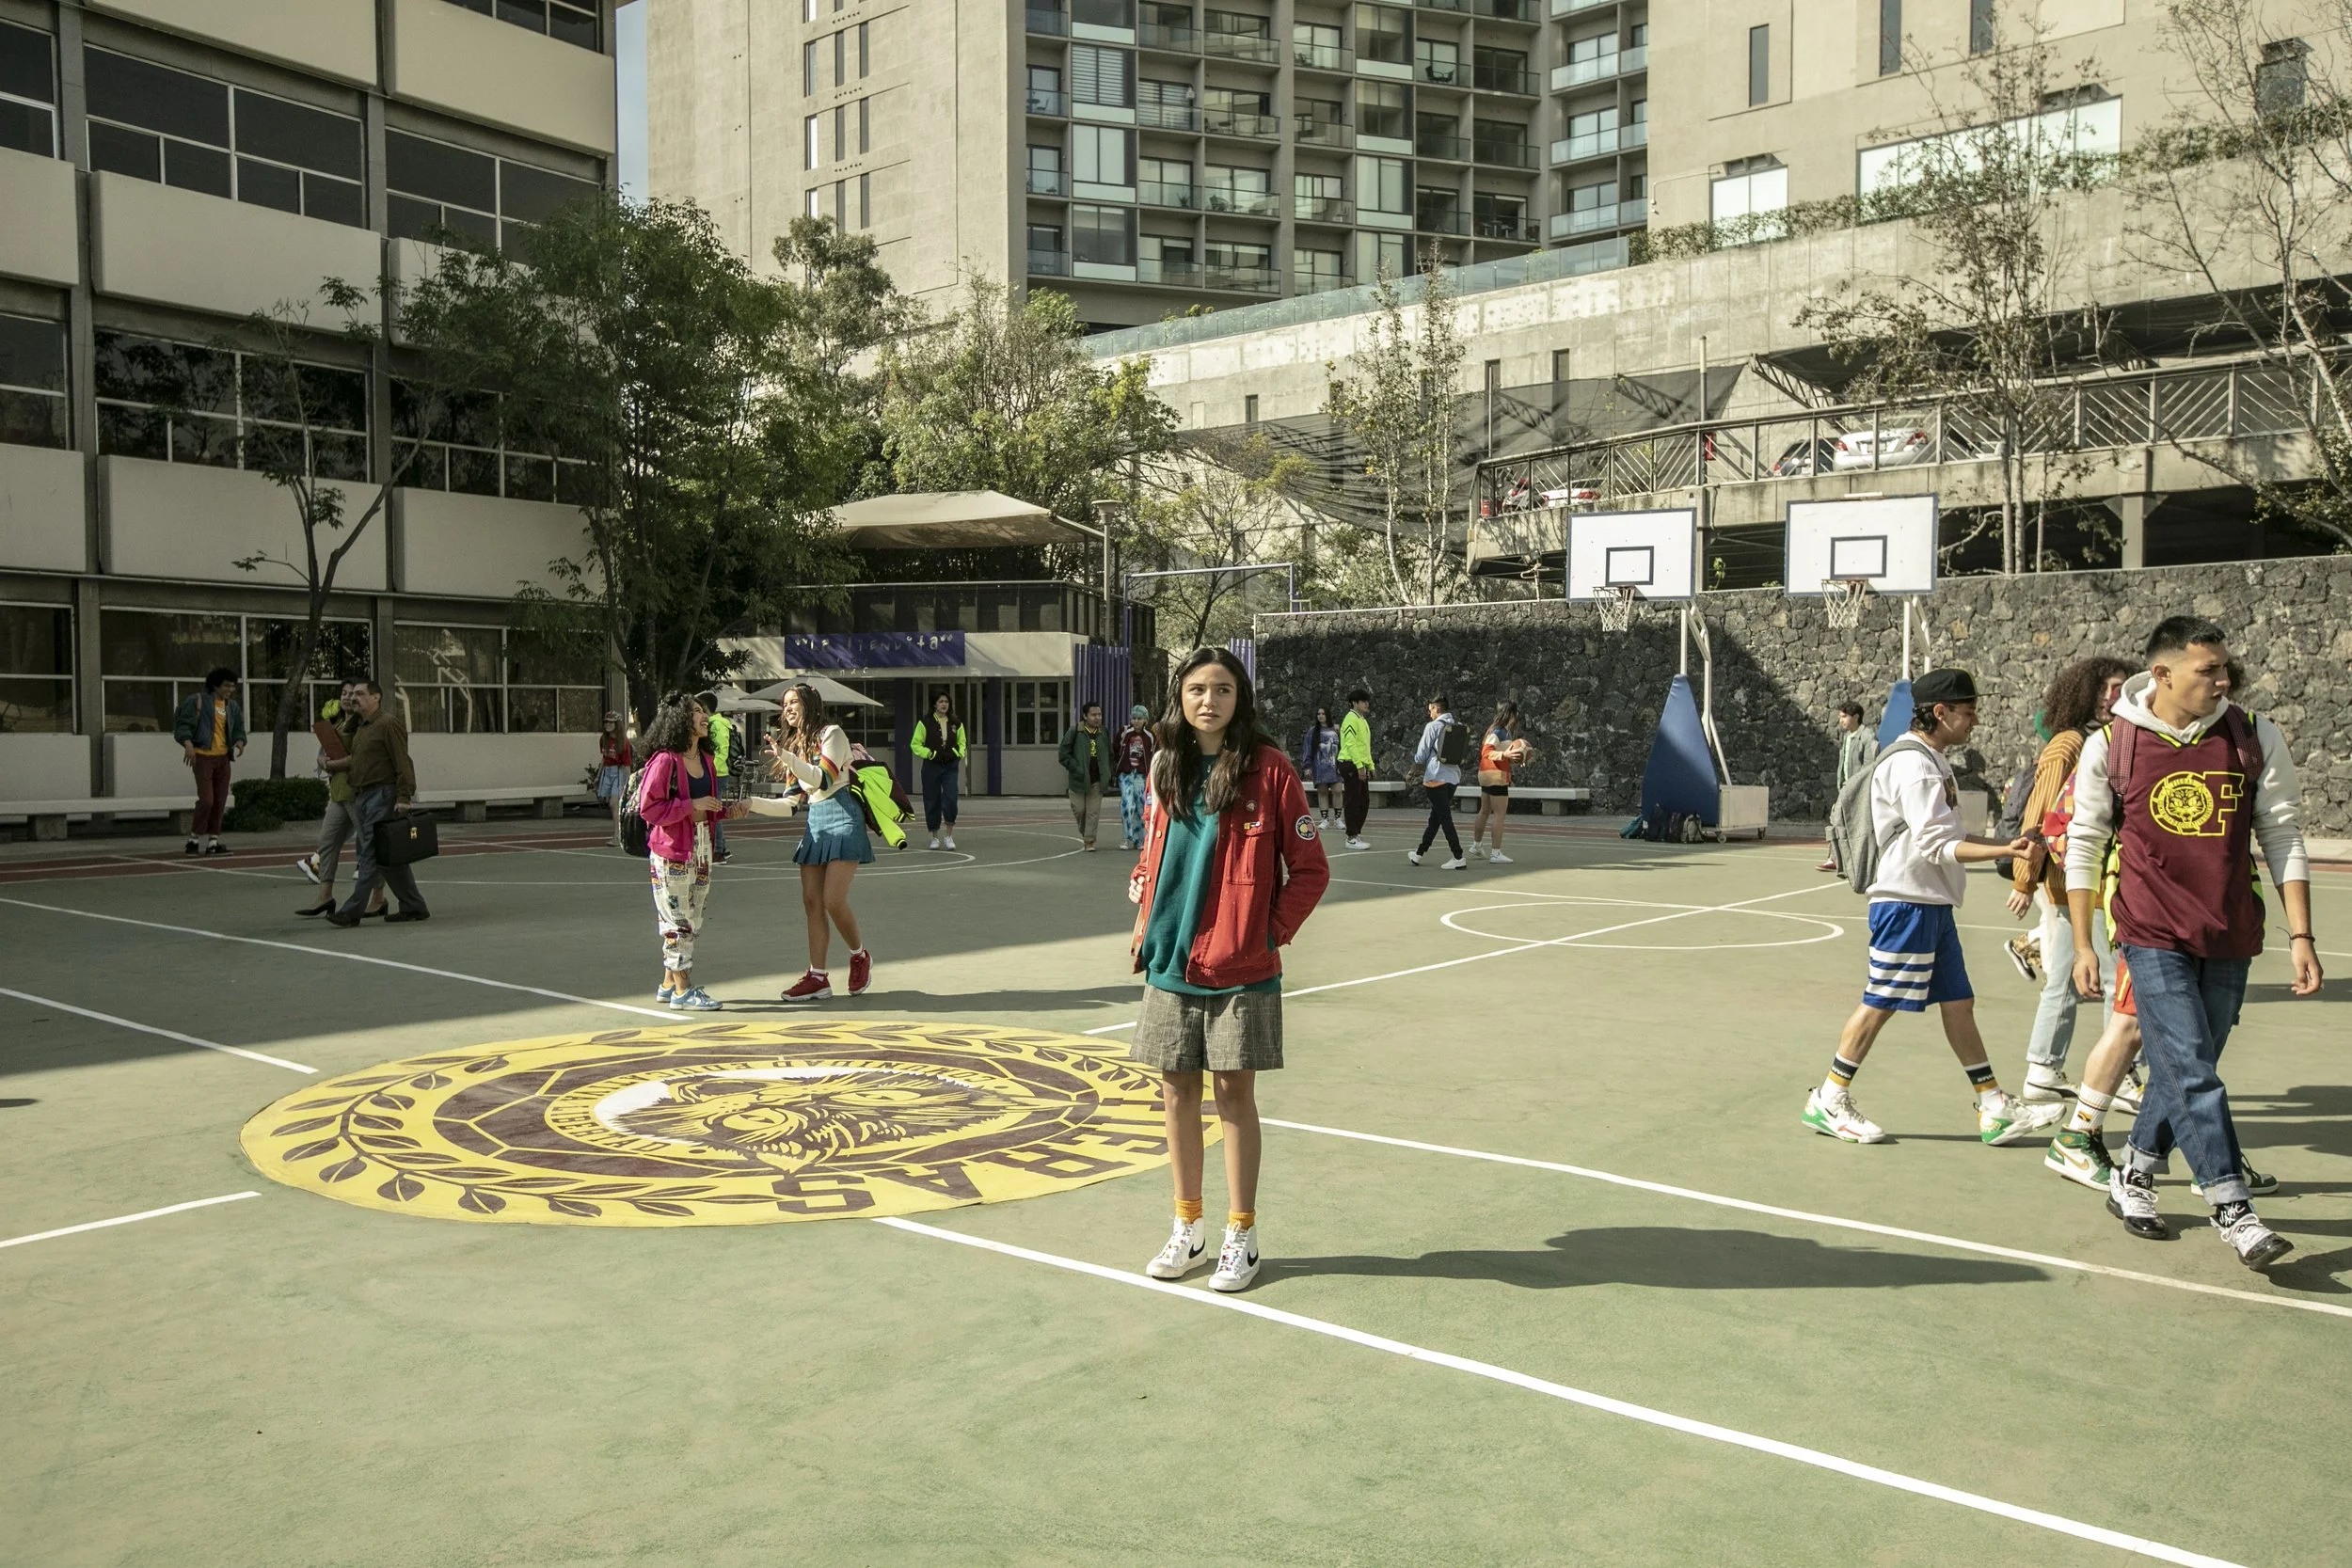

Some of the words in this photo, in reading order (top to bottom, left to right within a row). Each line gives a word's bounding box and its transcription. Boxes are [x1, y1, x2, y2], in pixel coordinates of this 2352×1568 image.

[565, 1062, 750, 1101] EDUCATIVA
[771, 1059, 997, 1083] COMUNIDAD
[552, 1101, 673, 1153] LIBERTAD
